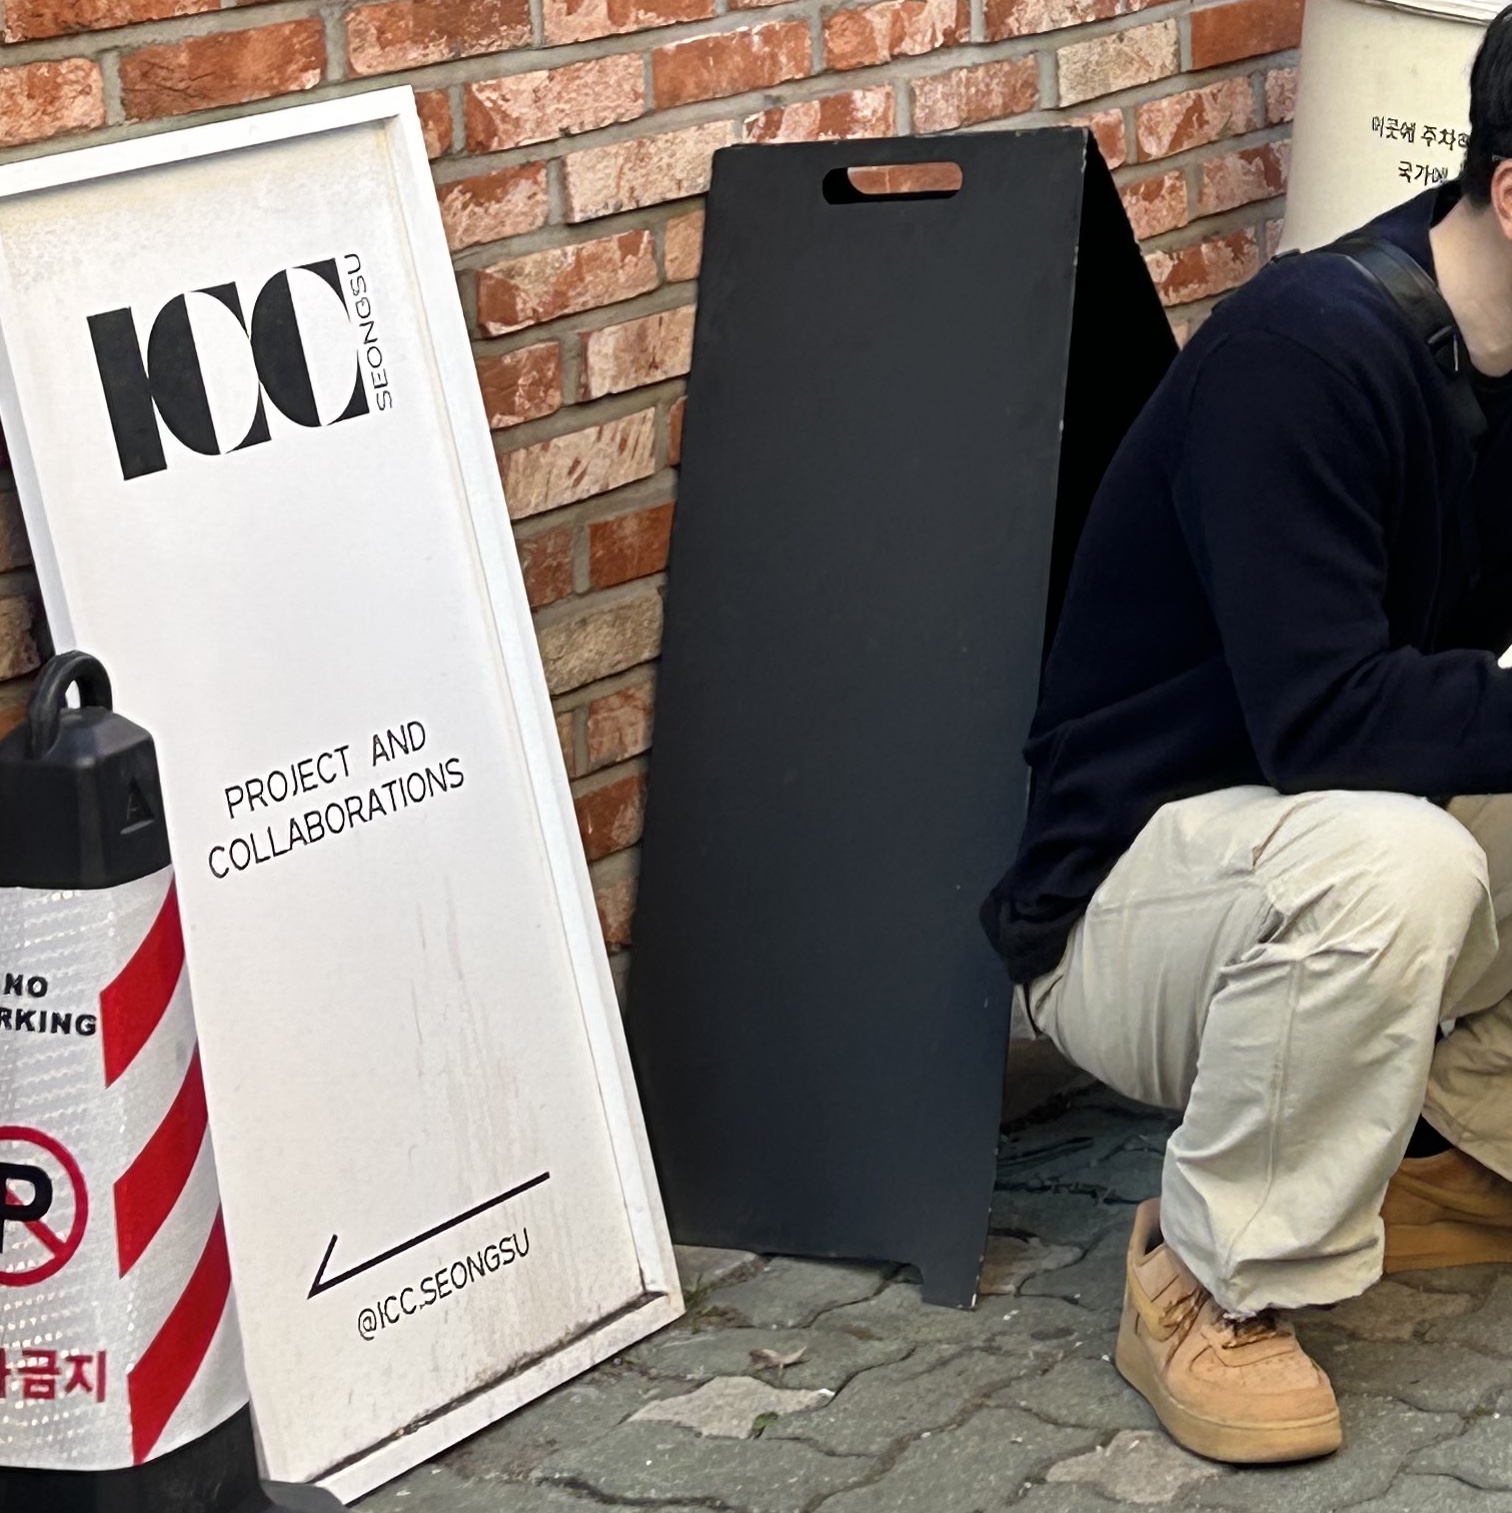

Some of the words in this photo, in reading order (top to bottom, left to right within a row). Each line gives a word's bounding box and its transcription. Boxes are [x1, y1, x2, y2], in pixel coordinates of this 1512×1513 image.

[86, 257, 370, 481] ICC
[343, 252, 393, 411] SEONGSU
[208, 757, 465, 879] COLLABORATIONS
[224, 744, 350, 819] PROJECT
[371, 719, 427, 767] AND
[3, 972, 48, 998] NO
[356, 1226, 531, 1342] @ICC.SEONGSU
